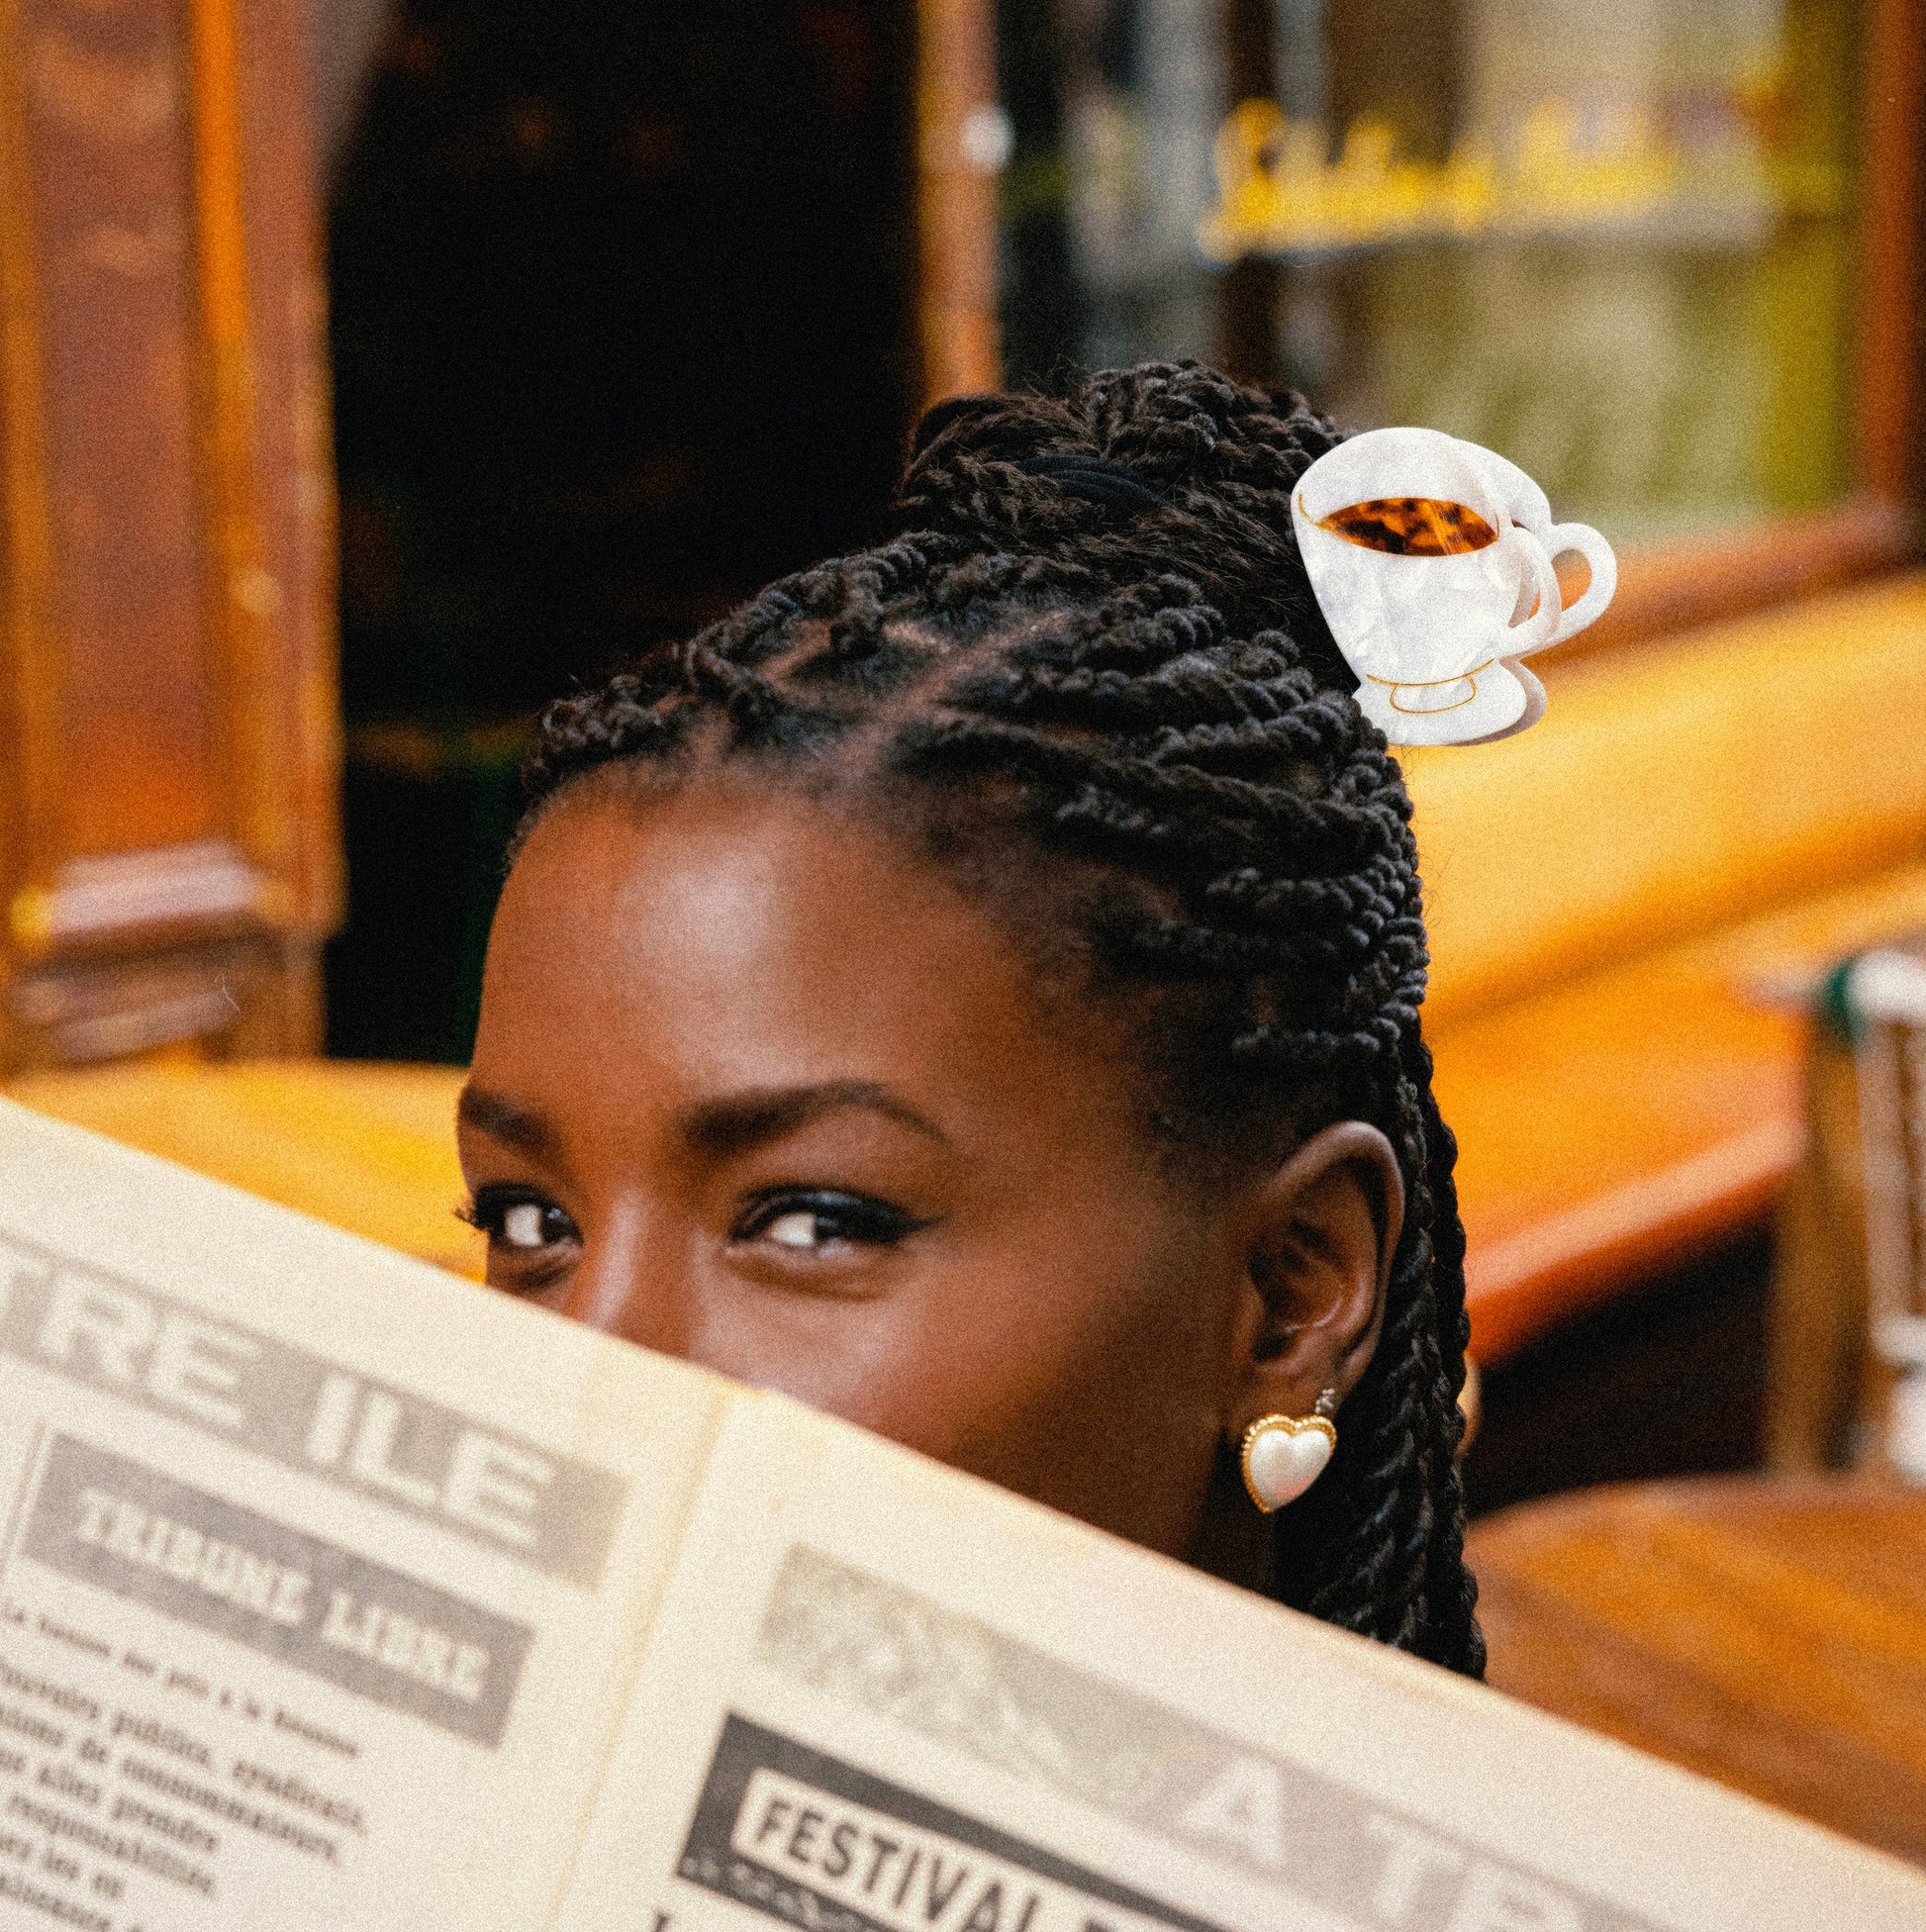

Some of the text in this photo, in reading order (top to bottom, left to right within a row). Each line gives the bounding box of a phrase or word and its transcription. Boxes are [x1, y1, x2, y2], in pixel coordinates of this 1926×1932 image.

[304, 1374, 554, 1548] ILE
[75, 1488, 492, 1701] TRIBUNE LIBRE
[1185, 1755, 1287, 1862] A
